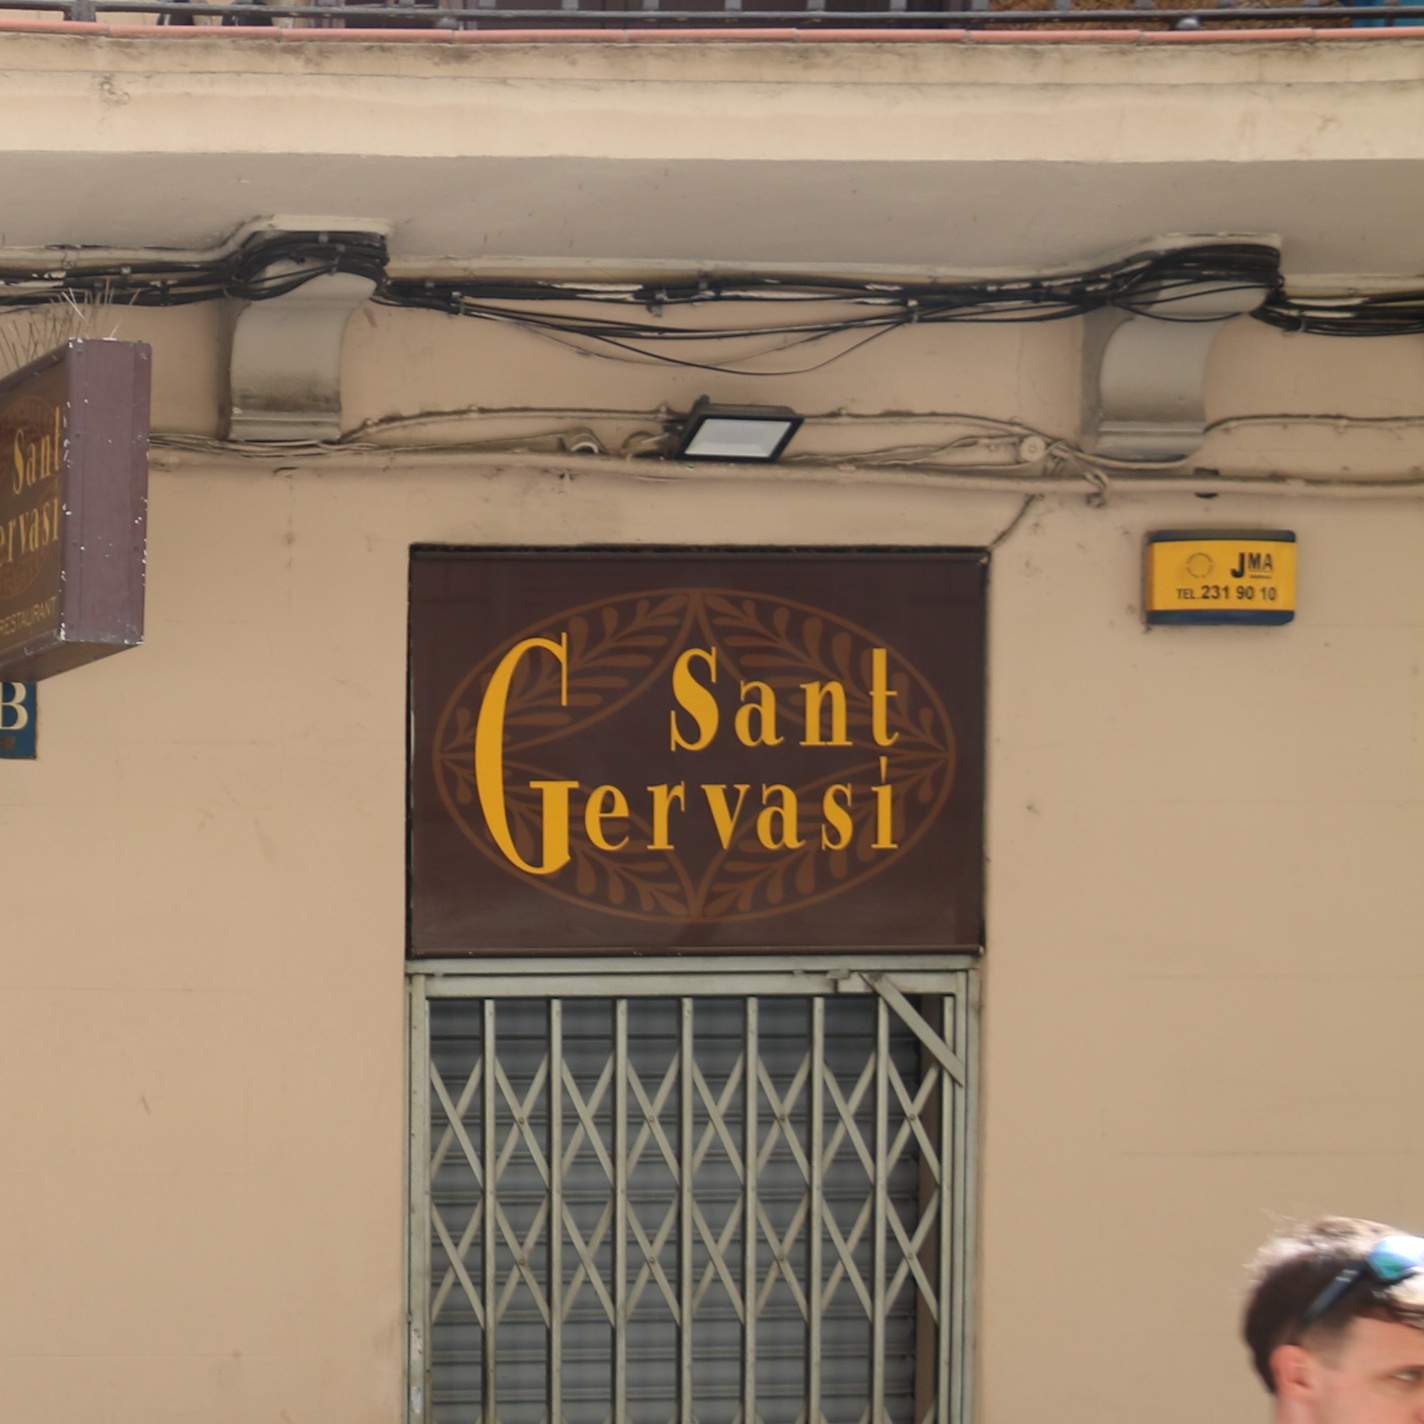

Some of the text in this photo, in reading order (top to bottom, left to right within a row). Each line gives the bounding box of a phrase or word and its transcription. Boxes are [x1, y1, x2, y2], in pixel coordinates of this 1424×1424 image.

[12, 405, 62, 495] Sant
[1201, 584, 1230, 600] 231
[1236, 586, 1254, 600] 90
[1261, 587, 1277, 601] 10
[1231, 552, 1273, 579] JMA
[670, 646, 899, 752] Sant
[474, 631, 899, 875] Gervasi
